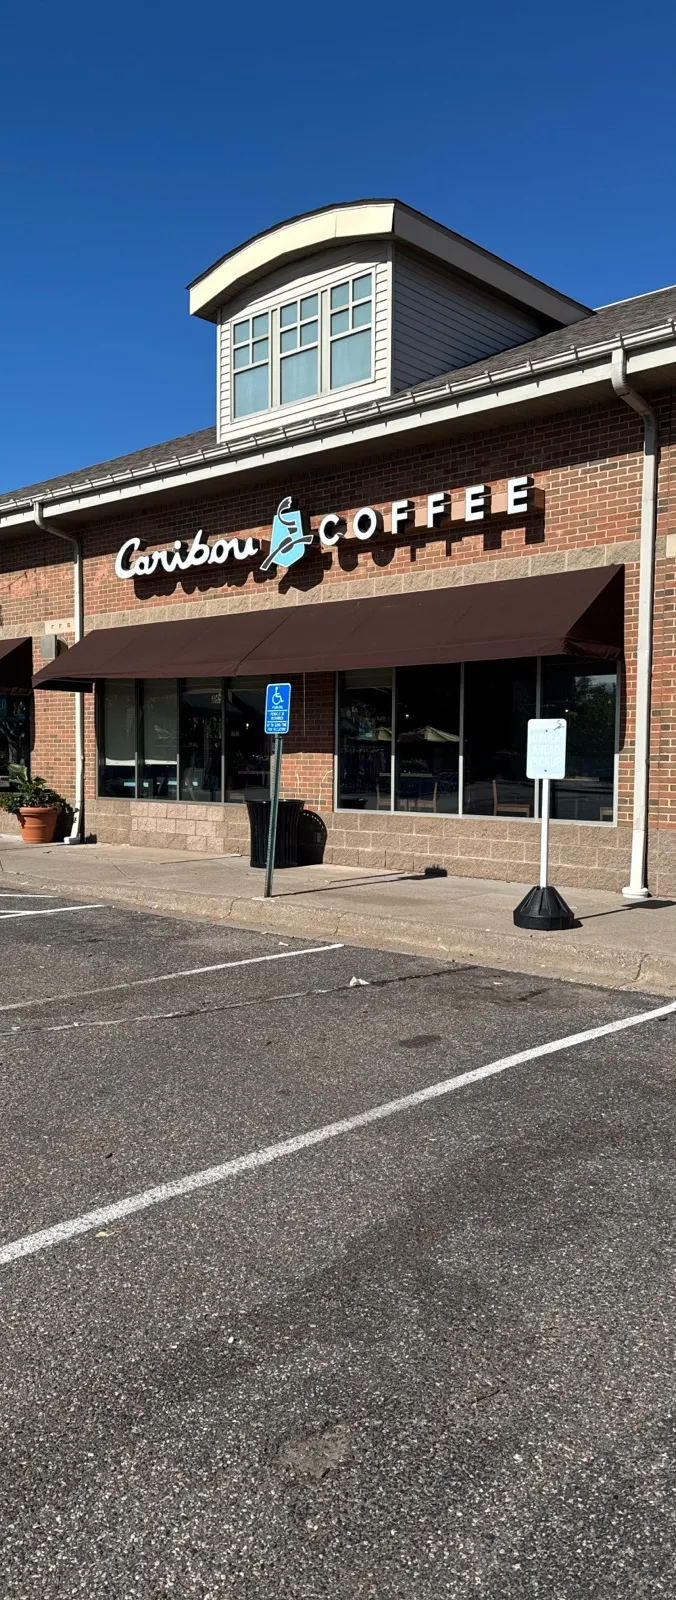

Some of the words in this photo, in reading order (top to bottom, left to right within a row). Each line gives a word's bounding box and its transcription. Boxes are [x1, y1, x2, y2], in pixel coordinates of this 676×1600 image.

[115, 530, 259, 579] Caribou
[318, 476, 535, 546] COFFEE
[532, 732, 561, 743] ORDER
[532, 744, 561, 755] AHEAD
[531, 756, 562, 767] PICKUP
